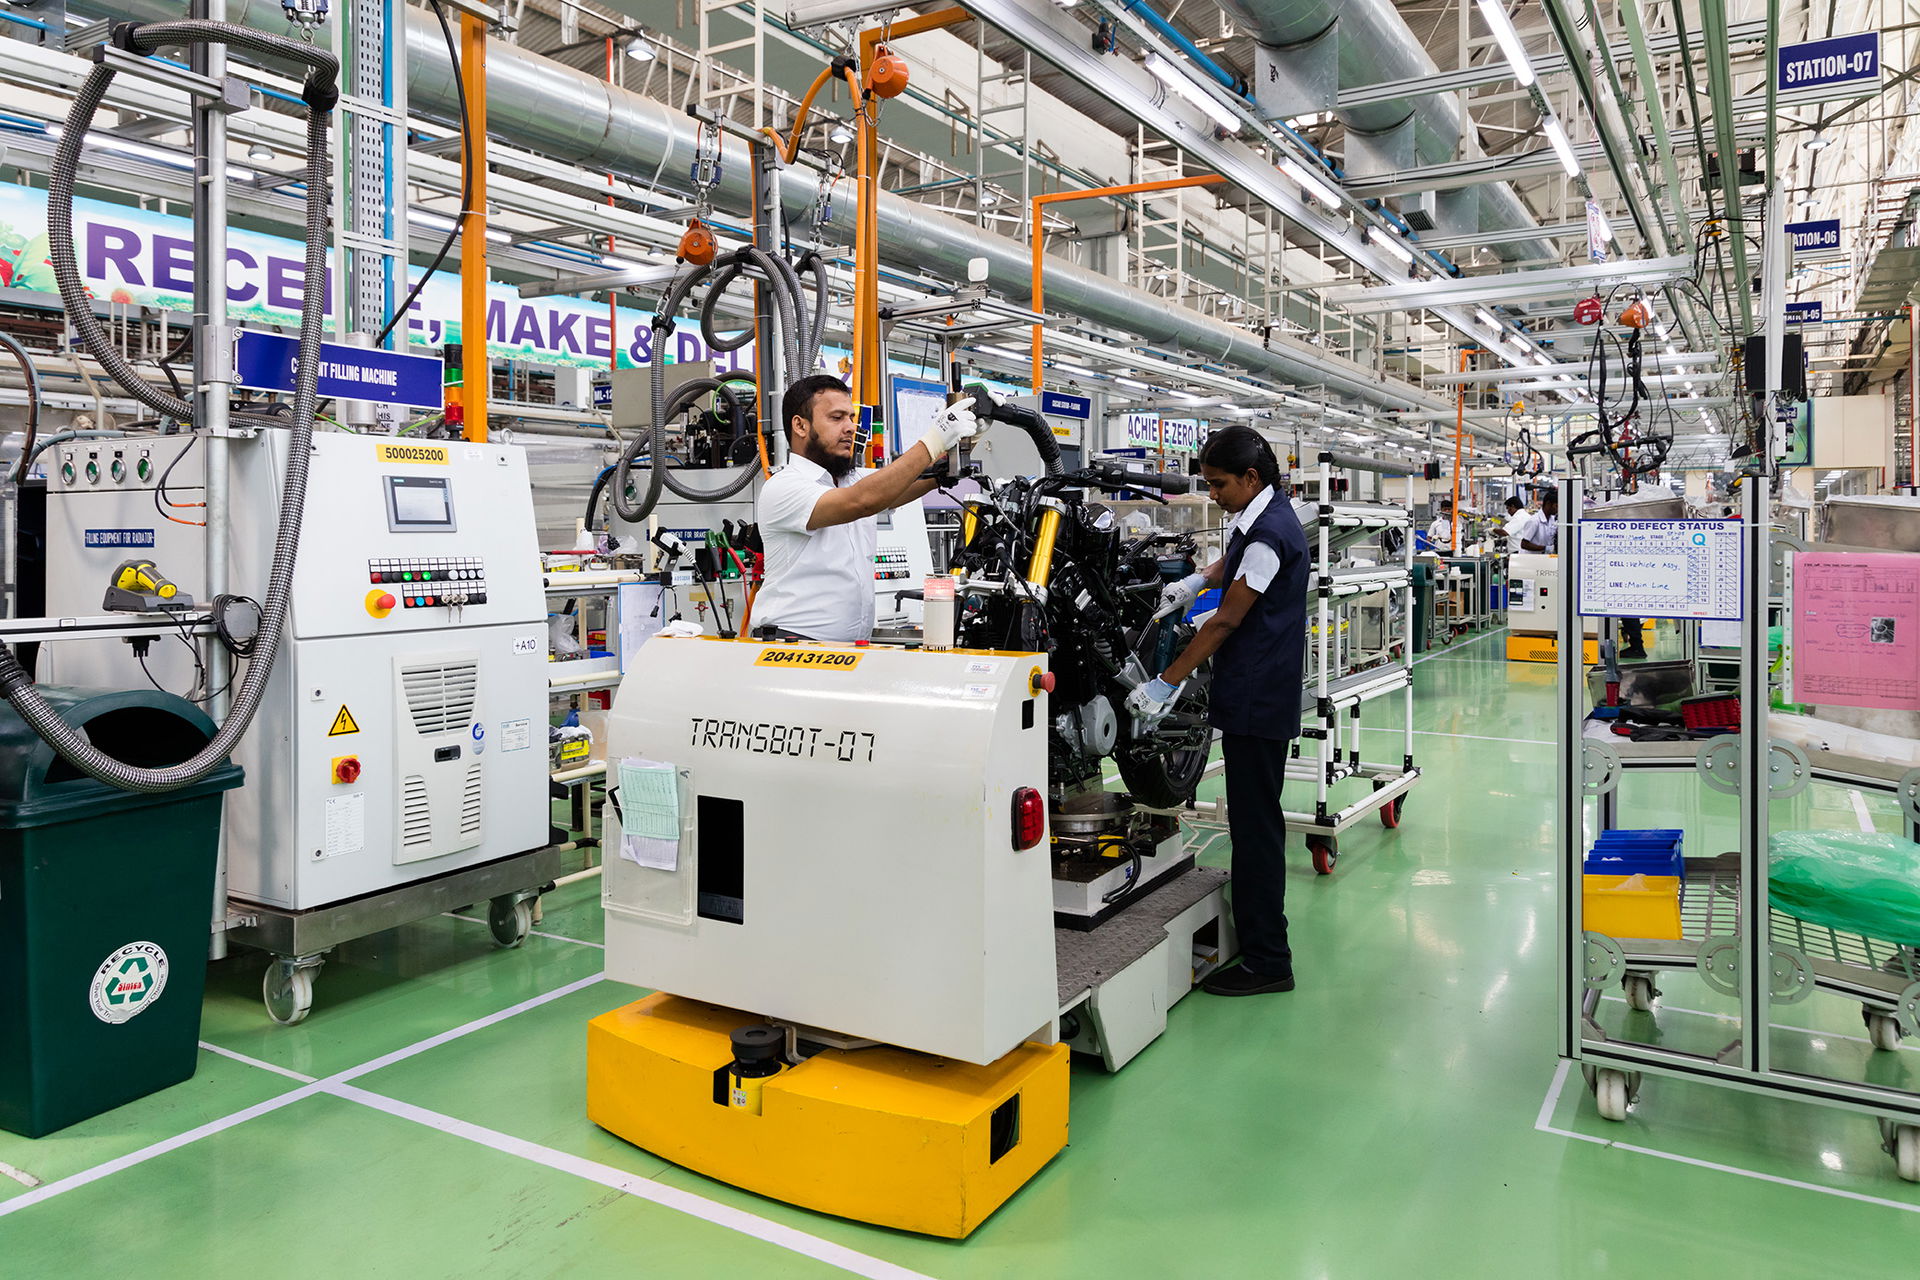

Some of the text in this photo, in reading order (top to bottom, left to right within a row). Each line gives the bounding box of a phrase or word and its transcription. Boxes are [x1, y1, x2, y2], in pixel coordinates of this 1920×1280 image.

[1786, 50, 1872, 82] STATION-07
[1793, 231, 1836, 247] ATION-06
[330, 363, 360, 382] FILLING
[361, 367, 397, 386] MACHINE
[1128, 415, 1169, 444] ACHIEE
[1172, 422, 1194, 447] ZERO
[385, 447, 444, 461] 500025200
[1596, 522, 1725, 530] ZERO DEFECT STATUS
[123, 532, 131, 544] FOR
[684, 531, 693, 539] FOR
[1692, 532, 1706, 546] Q
[515, 639, 536, 650] +A10
[763, 651, 856, 665] 204131200
[692, 718, 875, 762] TRANSBOT-07
[101, 945, 165, 974] RECYCLE
